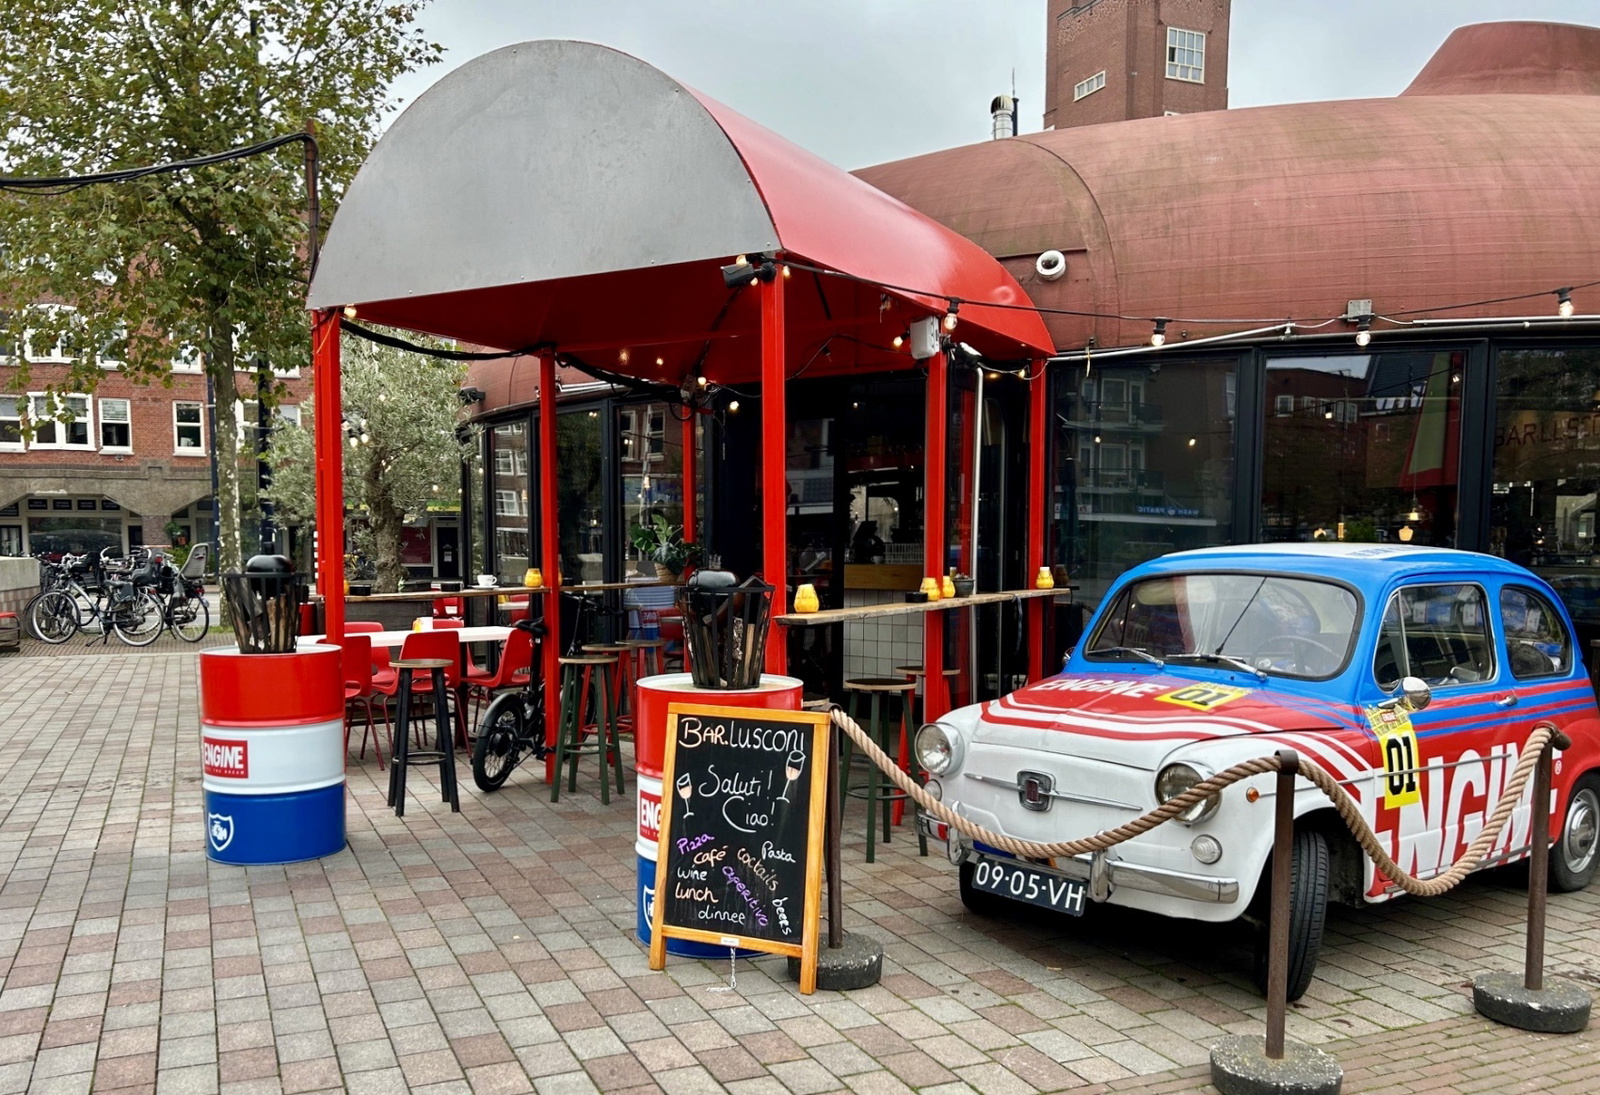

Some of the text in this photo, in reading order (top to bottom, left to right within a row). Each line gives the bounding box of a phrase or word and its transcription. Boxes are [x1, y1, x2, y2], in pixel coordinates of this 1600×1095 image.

[1029, 678, 1170, 698] ENGINE
[1170, 687, 1231, 706] 01
[204, 743, 244, 769] ENGINE
[1386, 735, 1416, 796] 01
[722, 796, 775, 833] Ciao!
[677, 833, 715, 855] Pizza
[761, 840, 797, 863] Pasta
[693, 845, 729, 867] café
[677, 864, 708, 881] wine
[675, 882, 719, 903] lunch
